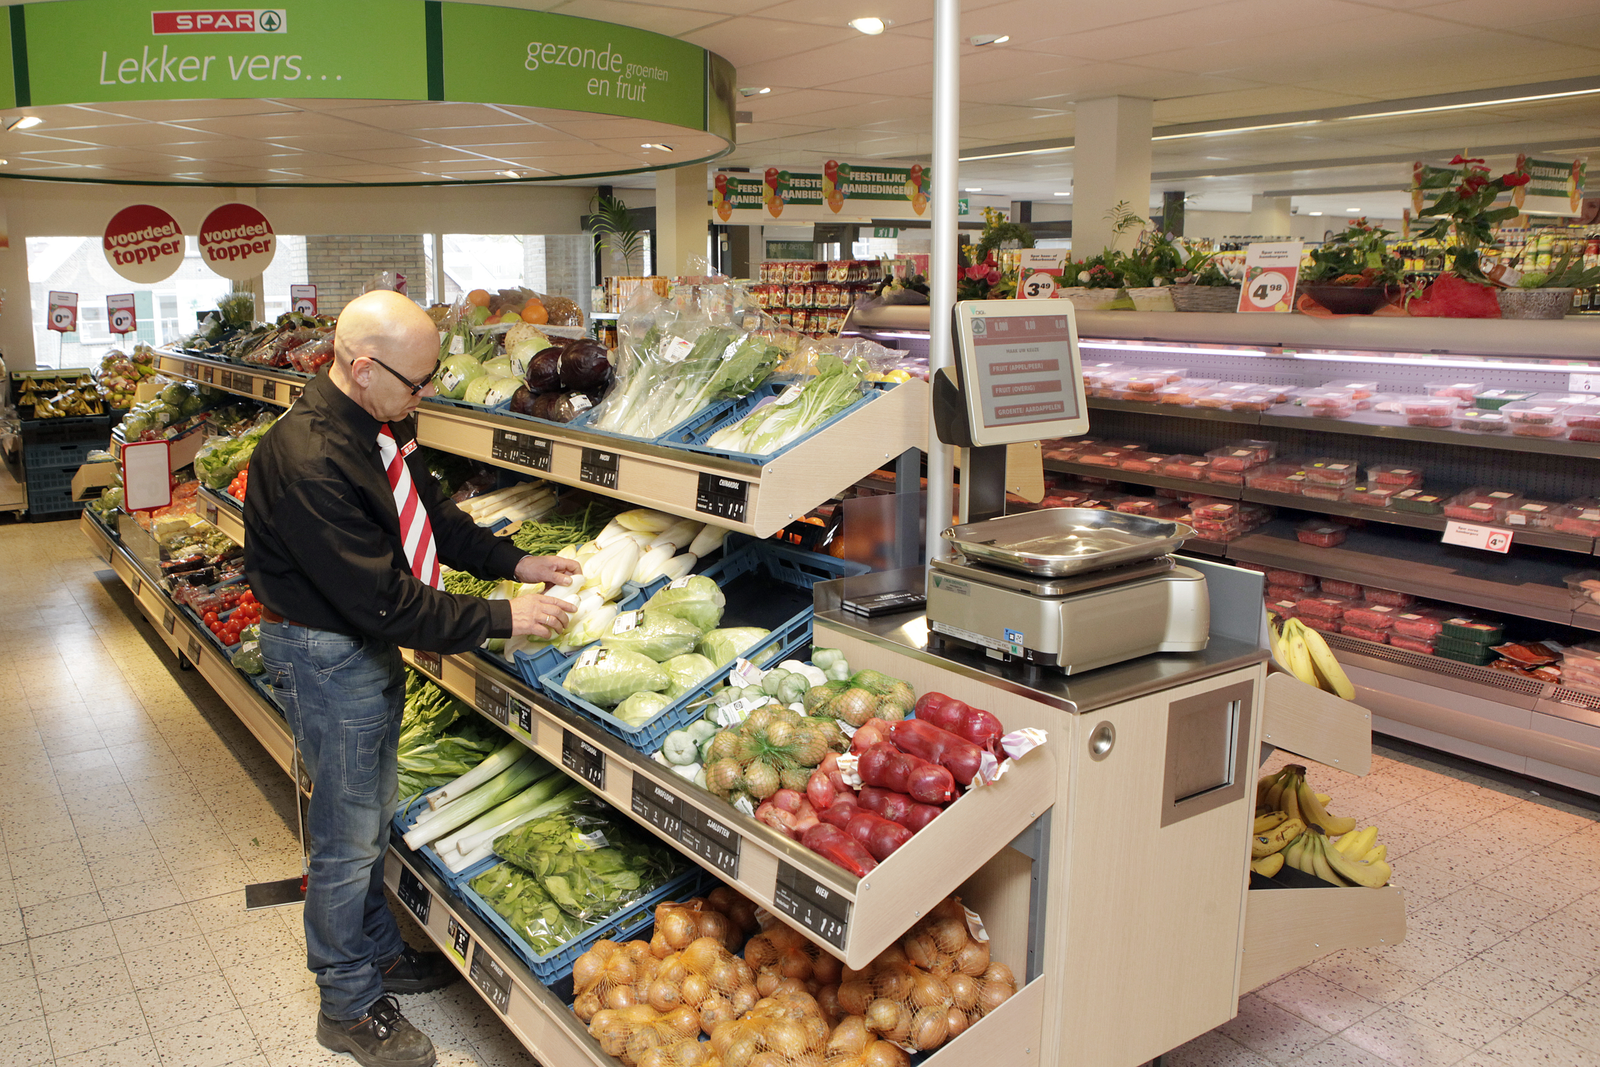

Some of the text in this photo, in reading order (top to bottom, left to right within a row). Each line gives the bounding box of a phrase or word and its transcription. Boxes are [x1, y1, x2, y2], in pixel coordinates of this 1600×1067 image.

[176, 14, 254, 30] SPAR
[99, 45, 342, 85] Lekker vers...
[524, 41, 669, 82] gezonde groenten
[587, 74, 647, 102] en fruit
[789, 178, 822, 188] FEESTE
[849, 171, 907, 183] FEESTELIJKE
[841, 183, 914, 195] AANBIEDINGEN!
[107, 221, 176, 247] voordeel
[203, 220, 268, 243] voordeel
[113, 237, 180, 265] topper
[207, 237, 271, 262] topper
[995, 384, 1036, 394] FRUIT (OVERIG)
[1025, 403, 1062, 413] AARDAPPELEN
[654, 786, 675, 804] KNOFLOOK
[706, 819, 730, 839] SJALOTTEN
[815, 885, 829, 900] UIEN
[820, 917, 842, 938] 1.29
